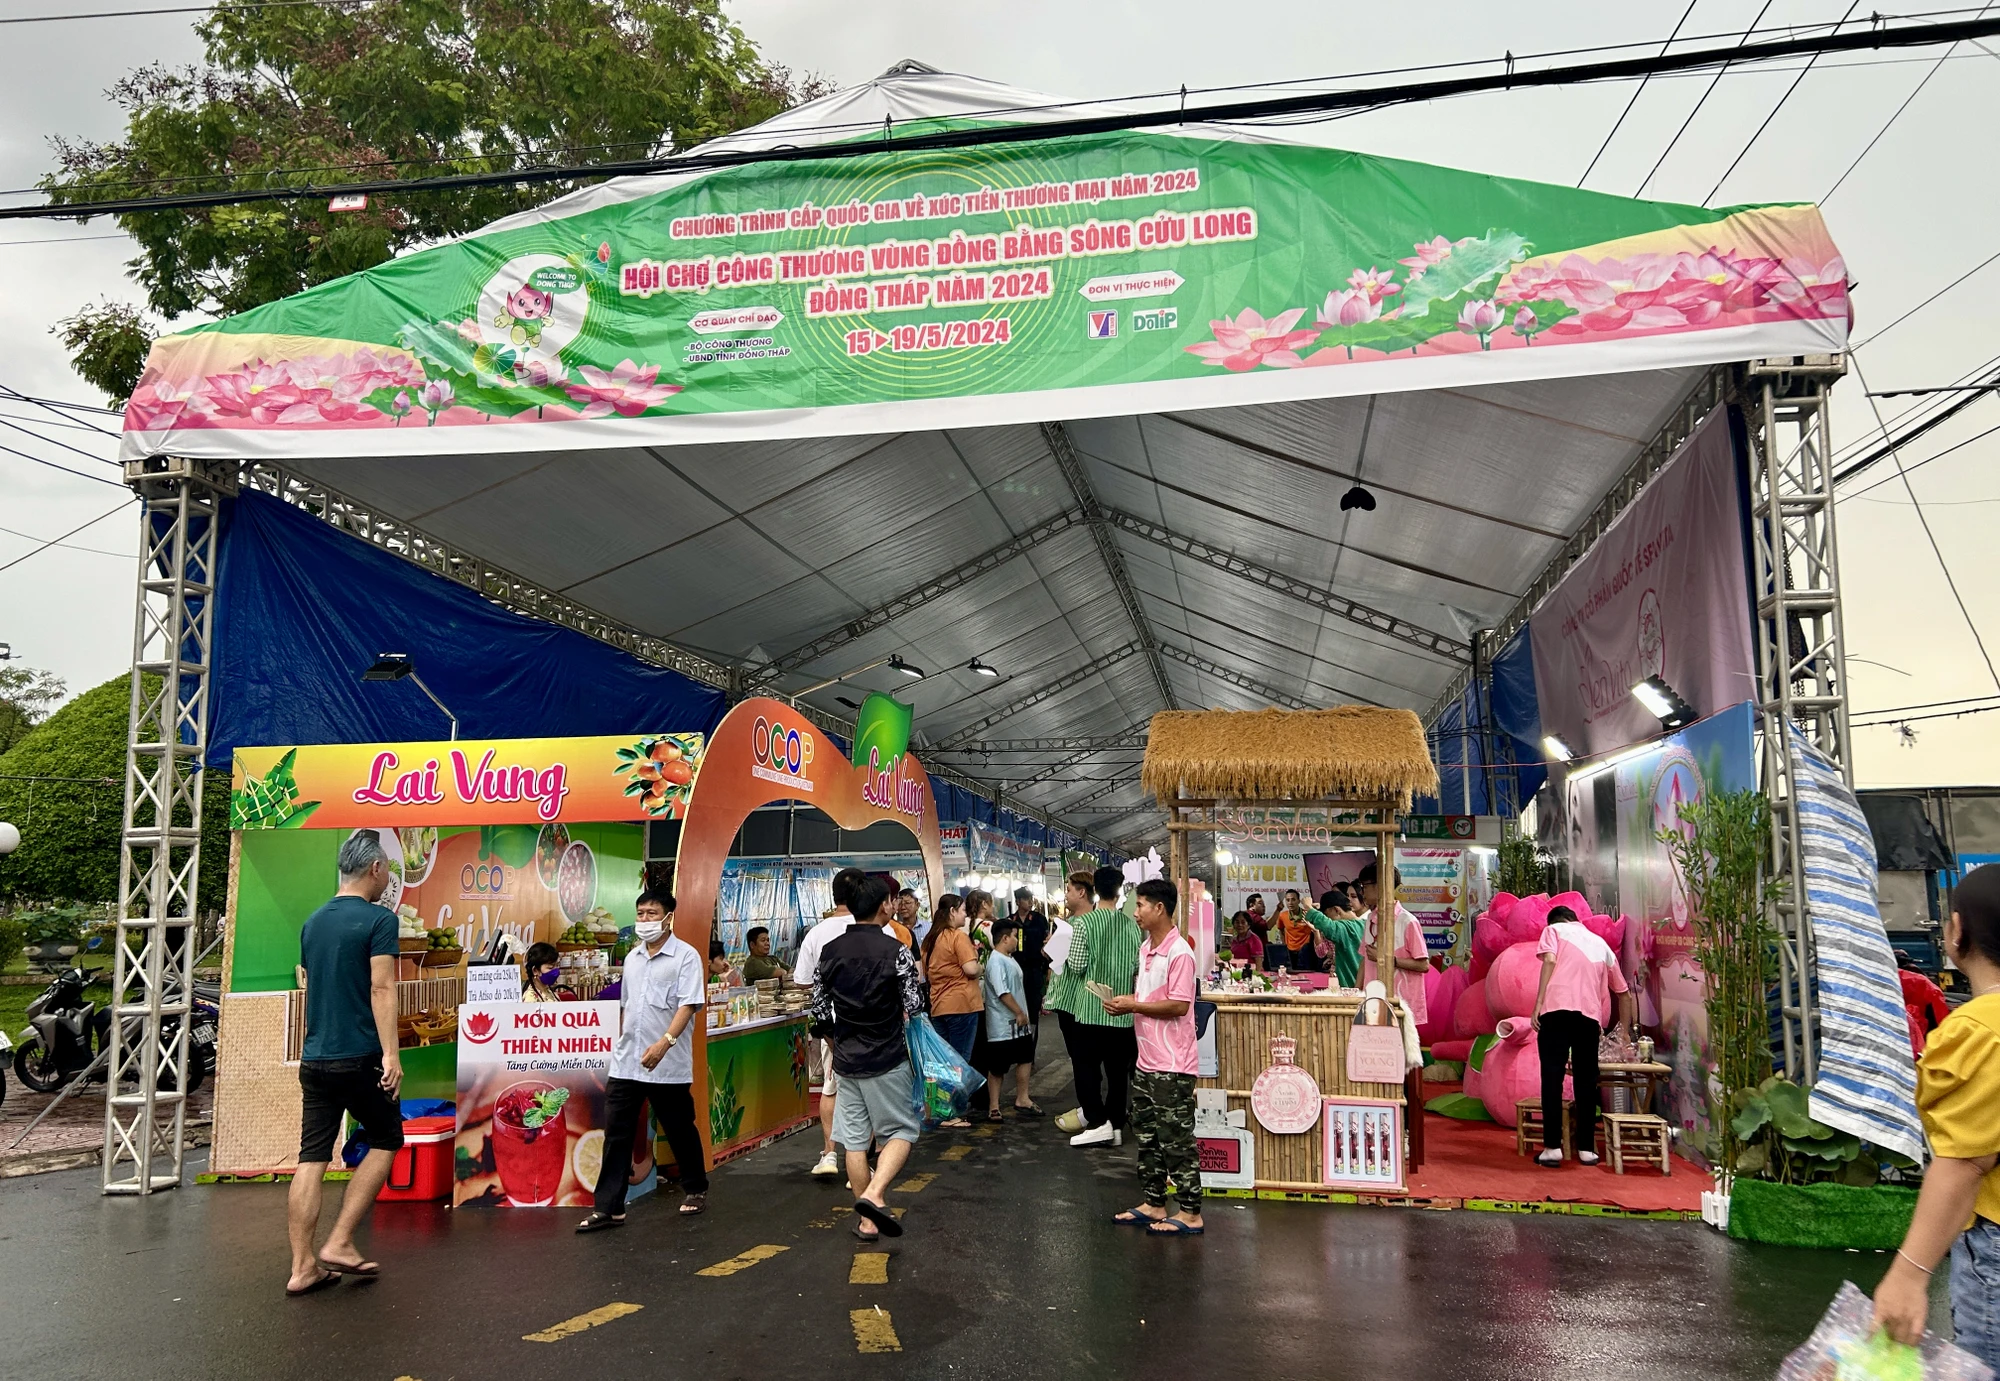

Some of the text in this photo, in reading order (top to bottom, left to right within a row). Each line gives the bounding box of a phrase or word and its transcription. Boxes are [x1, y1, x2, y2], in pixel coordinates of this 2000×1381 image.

[672, 171, 1197, 238] CHƯƠNG TRÌNH CẤP QUỐC GIA VỀ XÚC TIẾN THƯƠNG MẠI NĂM 2024
[624, 212, 1253, 293] HỘI CHỢ CÔNG THƯƠNG VÙNG ĐỒNG BẰNG SÔNG CỬU LONG
[536, 272, 567, 280] WELCOME
[809, 272, 1049, 313] ĐỒNG THÁP NĂM 2024
[1088, 277, 1176, 294] ĐƠN VỊ THỰC HIỆN
[694, 318, 709, 327] CƠ
[711, 316, 736, 326] QUAN
[757, 313, 778, 325] ĐẠO
[690, 337, 773, 351] BỘ CÔNG THƯƠNG
[846, 320, 1010, 353] 15 19/5/2024
[689, 346, 791, 362] UBND TỈNH ĐỒNG THÁP
[751, 715, 815, 779] OCOP
[353, 747, 569, 821] Lai Vung
[863, 746, 925, 836] Lai Vung
[1270, 852, 1300, 860] DƯỠNG
[460, 862, 516, 894] OCOP
[1226, 865, 1298, 882] NATURE
[1452, 886, 1458, 895] 3
[561, 1008, 601, 1029] QUÀ
[501, 1034, 612, 1055] THIÊN NHIÊN
[530, 1059, 559, 1072] Cường
[560, 1057, 583, 1070] Miễn
[584, 1059, 605, 1071] Dịch
[1360, 1057, 1395, 1067] YOUNG
[1199, 1160, 1229, 1170] OUNG
